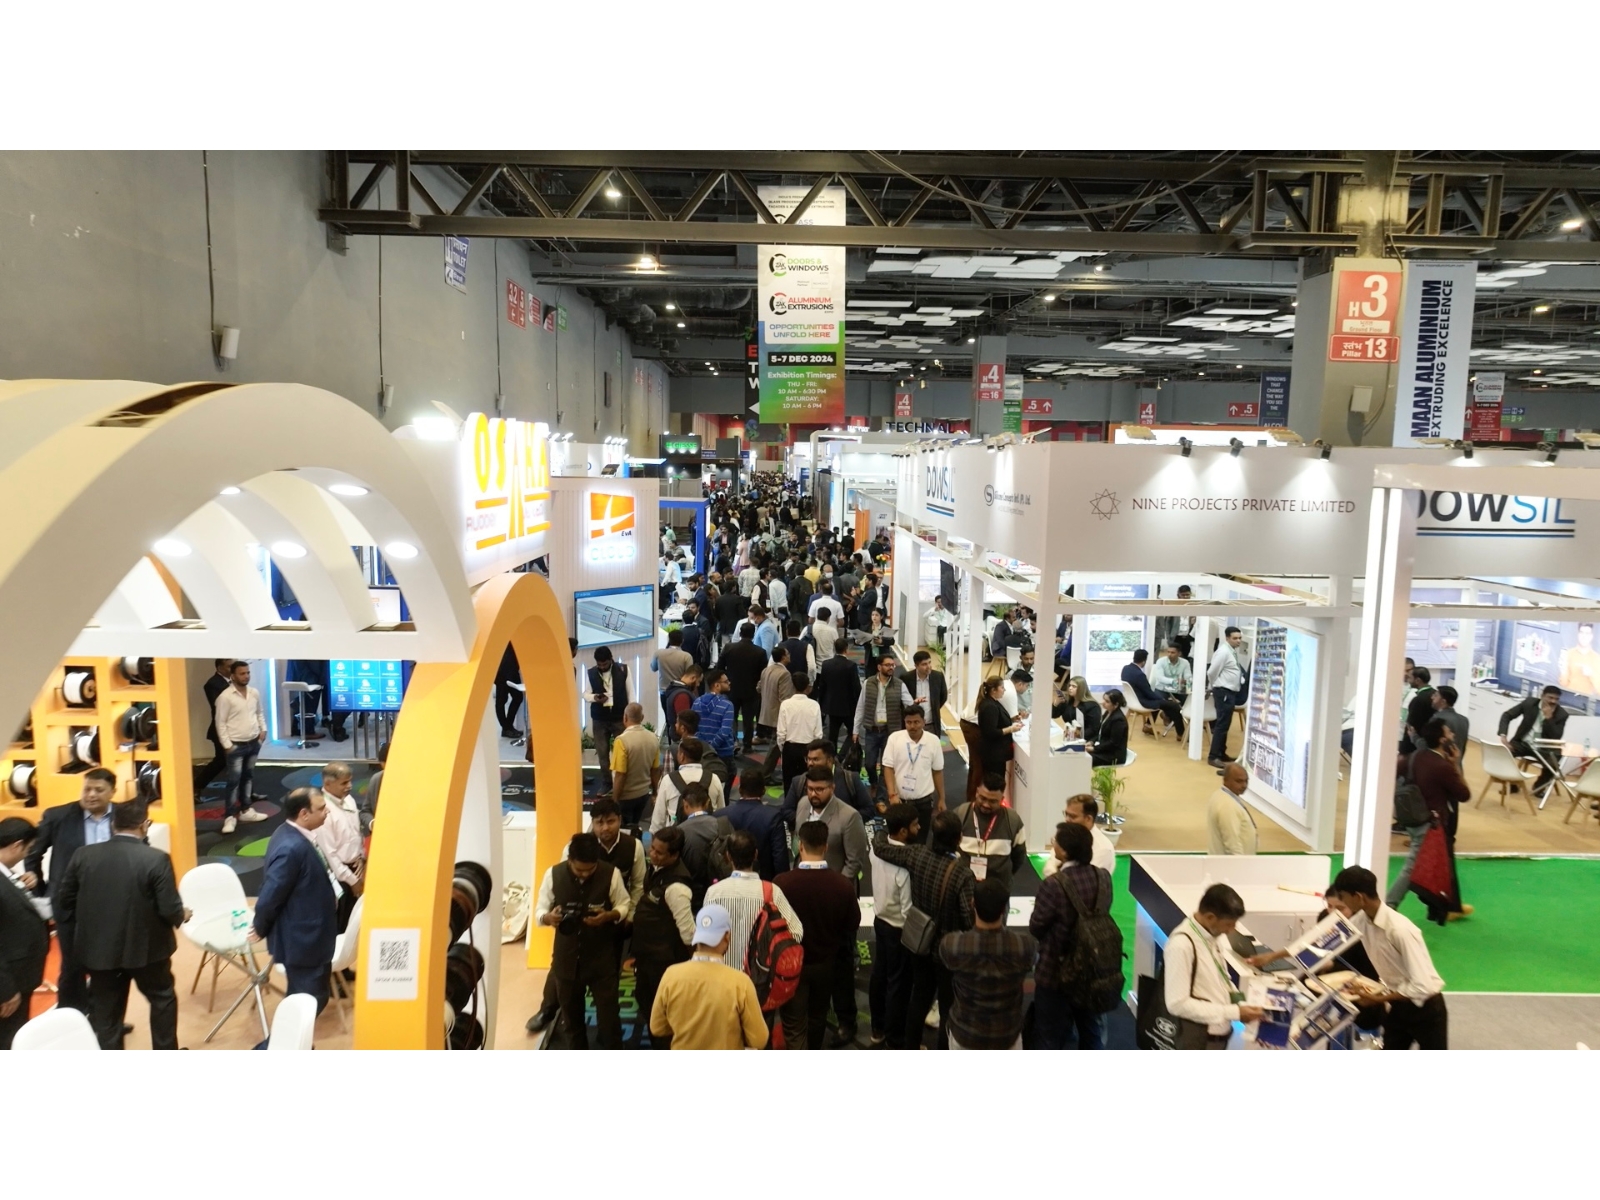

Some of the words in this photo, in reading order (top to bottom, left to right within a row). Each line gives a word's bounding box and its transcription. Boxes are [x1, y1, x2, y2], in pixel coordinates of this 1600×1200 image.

[1415, 280, 1442, 383] ALUMINIUM
[1437, 280, 1453, 358] EXCELENCE
[1364, 338, 1387, 358] 13
[806, 372, 837, 380] Timings:
[1410, 386, 1433, 438] MAAN
[1431, 362, 1446, 438] EXTRUDING
[886, 422, 949, 434] TECHNAL
[926, 466, 955, 502] DOWSIL
[1132, 498, 1167, 510] NINE
[1172, 498, 1238, 511] PROJECTS
[1242, 499, 1296, 512] PRIVATE
[1301, 500, 1355, 513] LIMITED
